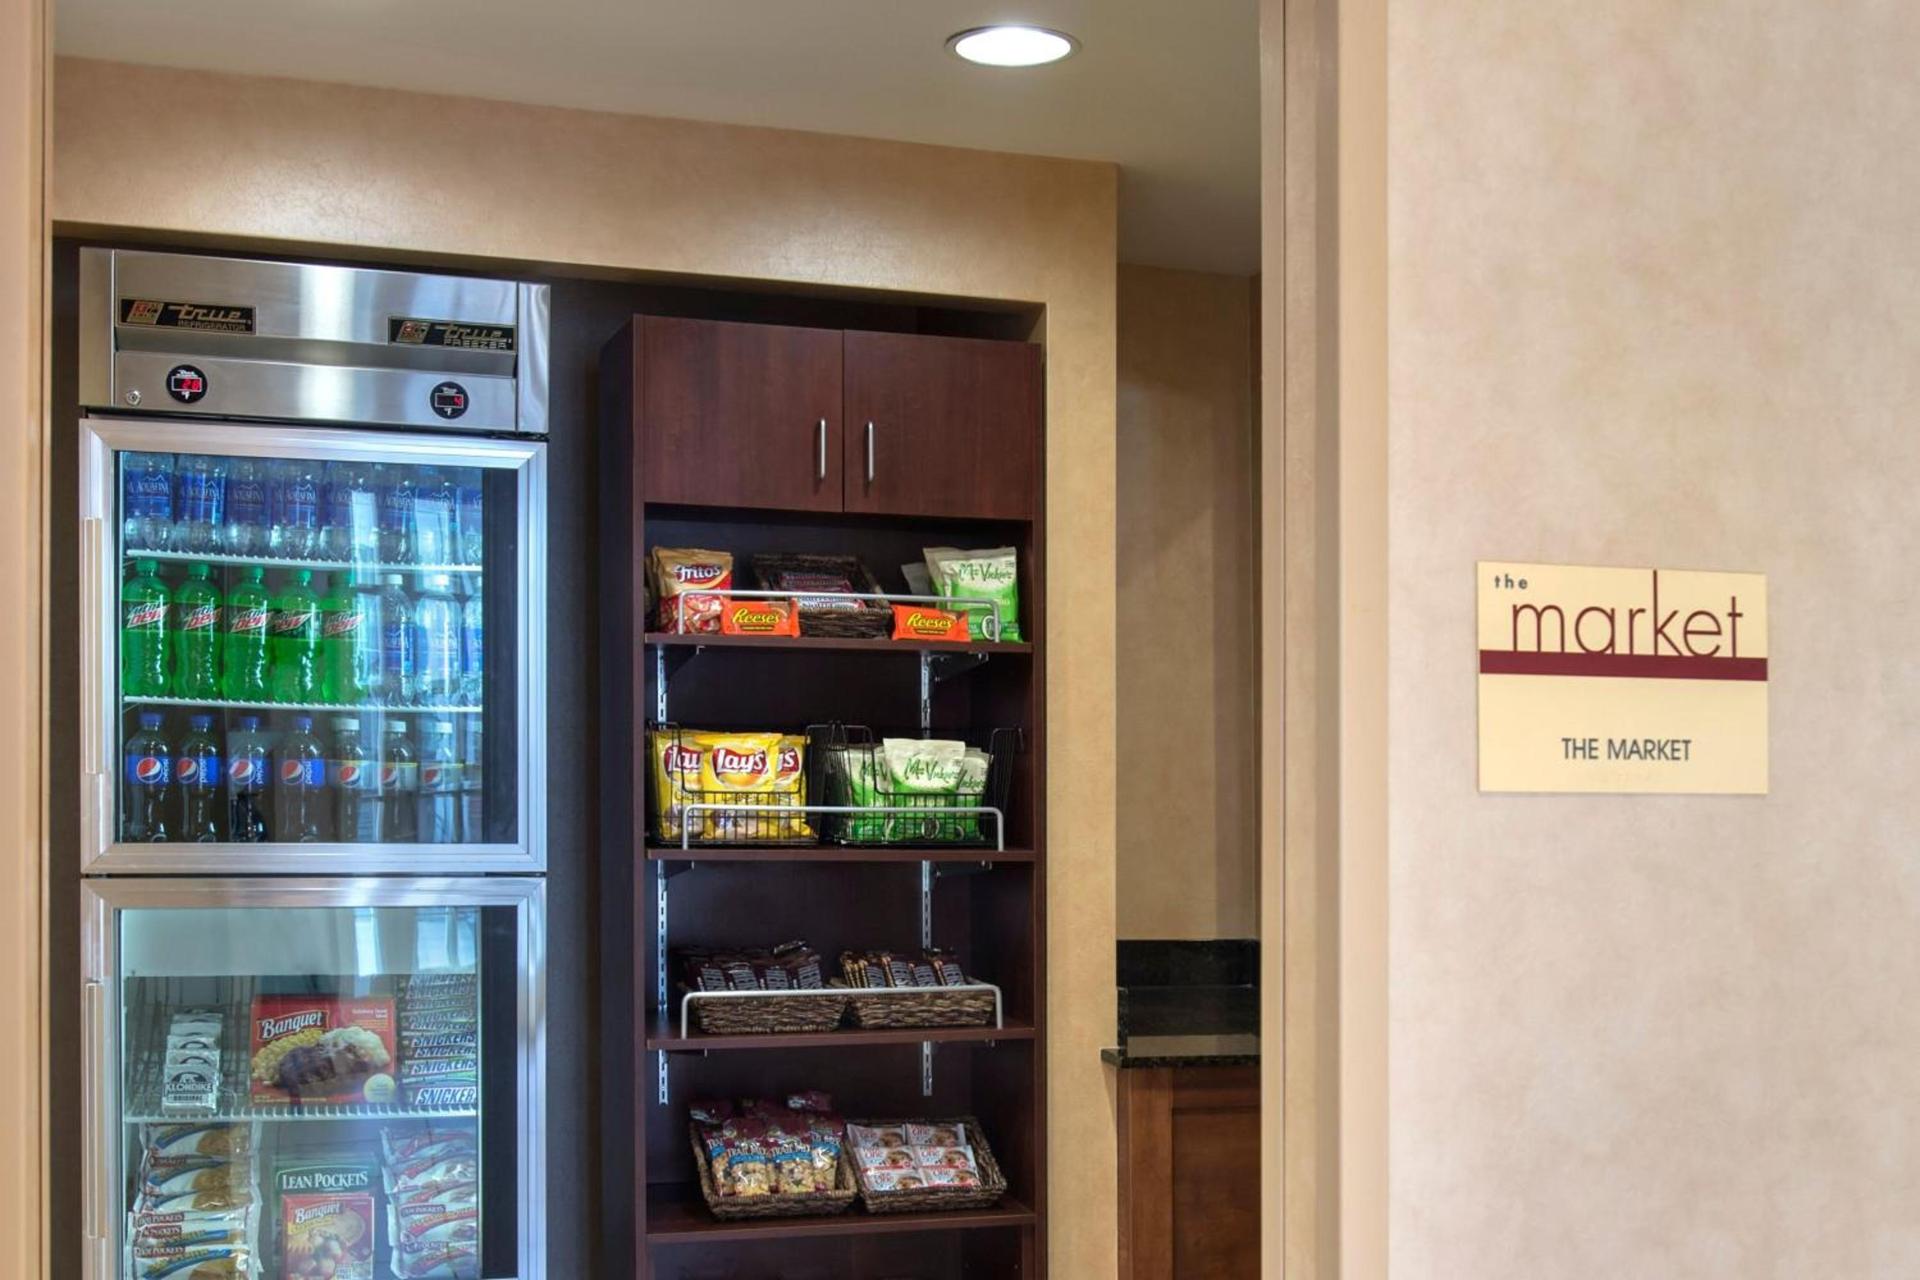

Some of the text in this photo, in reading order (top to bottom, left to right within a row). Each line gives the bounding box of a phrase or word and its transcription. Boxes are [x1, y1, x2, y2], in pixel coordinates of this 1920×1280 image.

[443, 338, 507, 349] FREEZER
[1494, 574, 1529, 590] the
[1512, 569, 1744, 657] market
[1561, 737, 1692, 761] THE MARKET
[716, 748, 765, 773] Lay's
[261, 1010, 322, 1039] Banquet
[165, 1081, 213, 1094] KLONDIKE
[282, 1171, 368, 1190] LEAN POCKETS
[294, 1202, 340, 1224] Banquet
